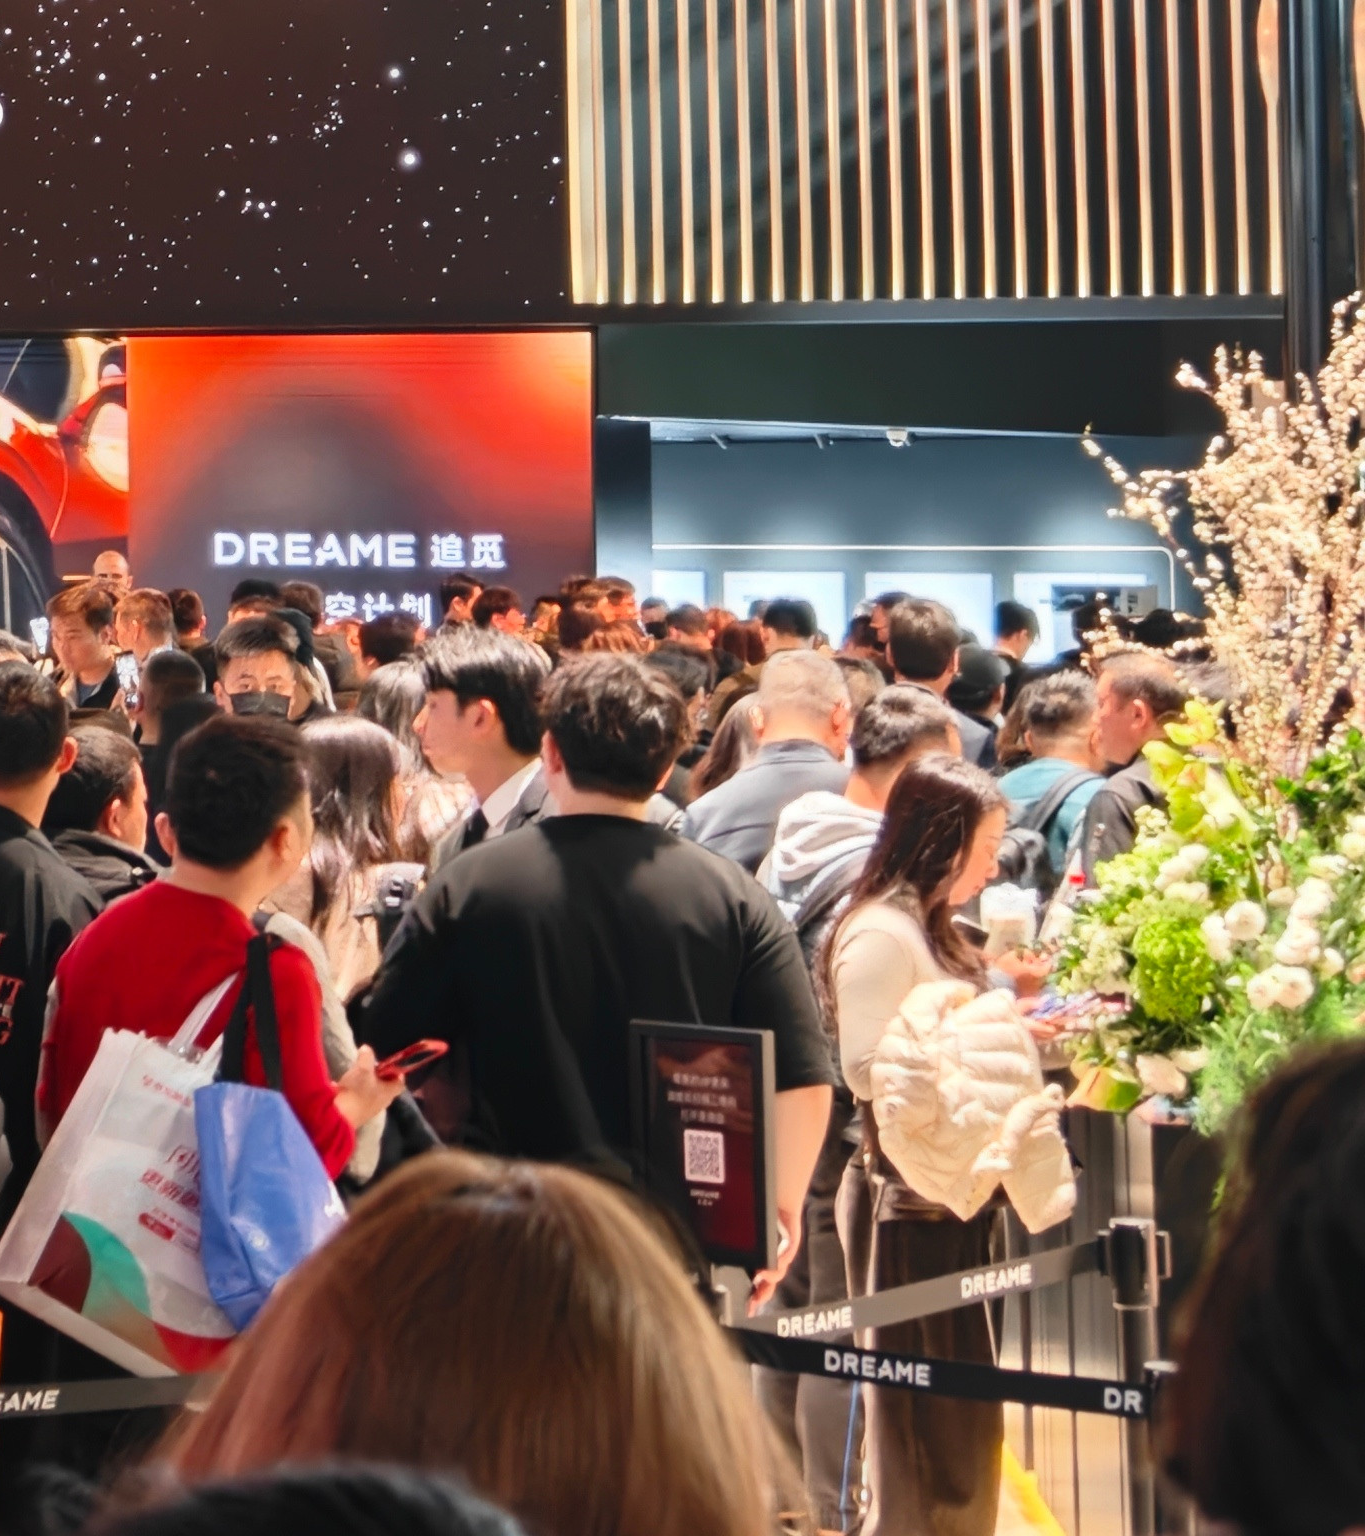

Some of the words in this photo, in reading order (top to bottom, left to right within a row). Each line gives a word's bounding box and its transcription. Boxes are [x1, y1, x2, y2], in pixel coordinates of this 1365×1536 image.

[213, 531, 416, 568] DREAME
[430, 533, 506, 569] 追觅
[324, 592, 432, 628] 空计划
[960, 1263, 1033, 1300] DREAME
[776, 1305, 853, 1338] DREAME
[823, 1348, 931, 1388] DREAME
